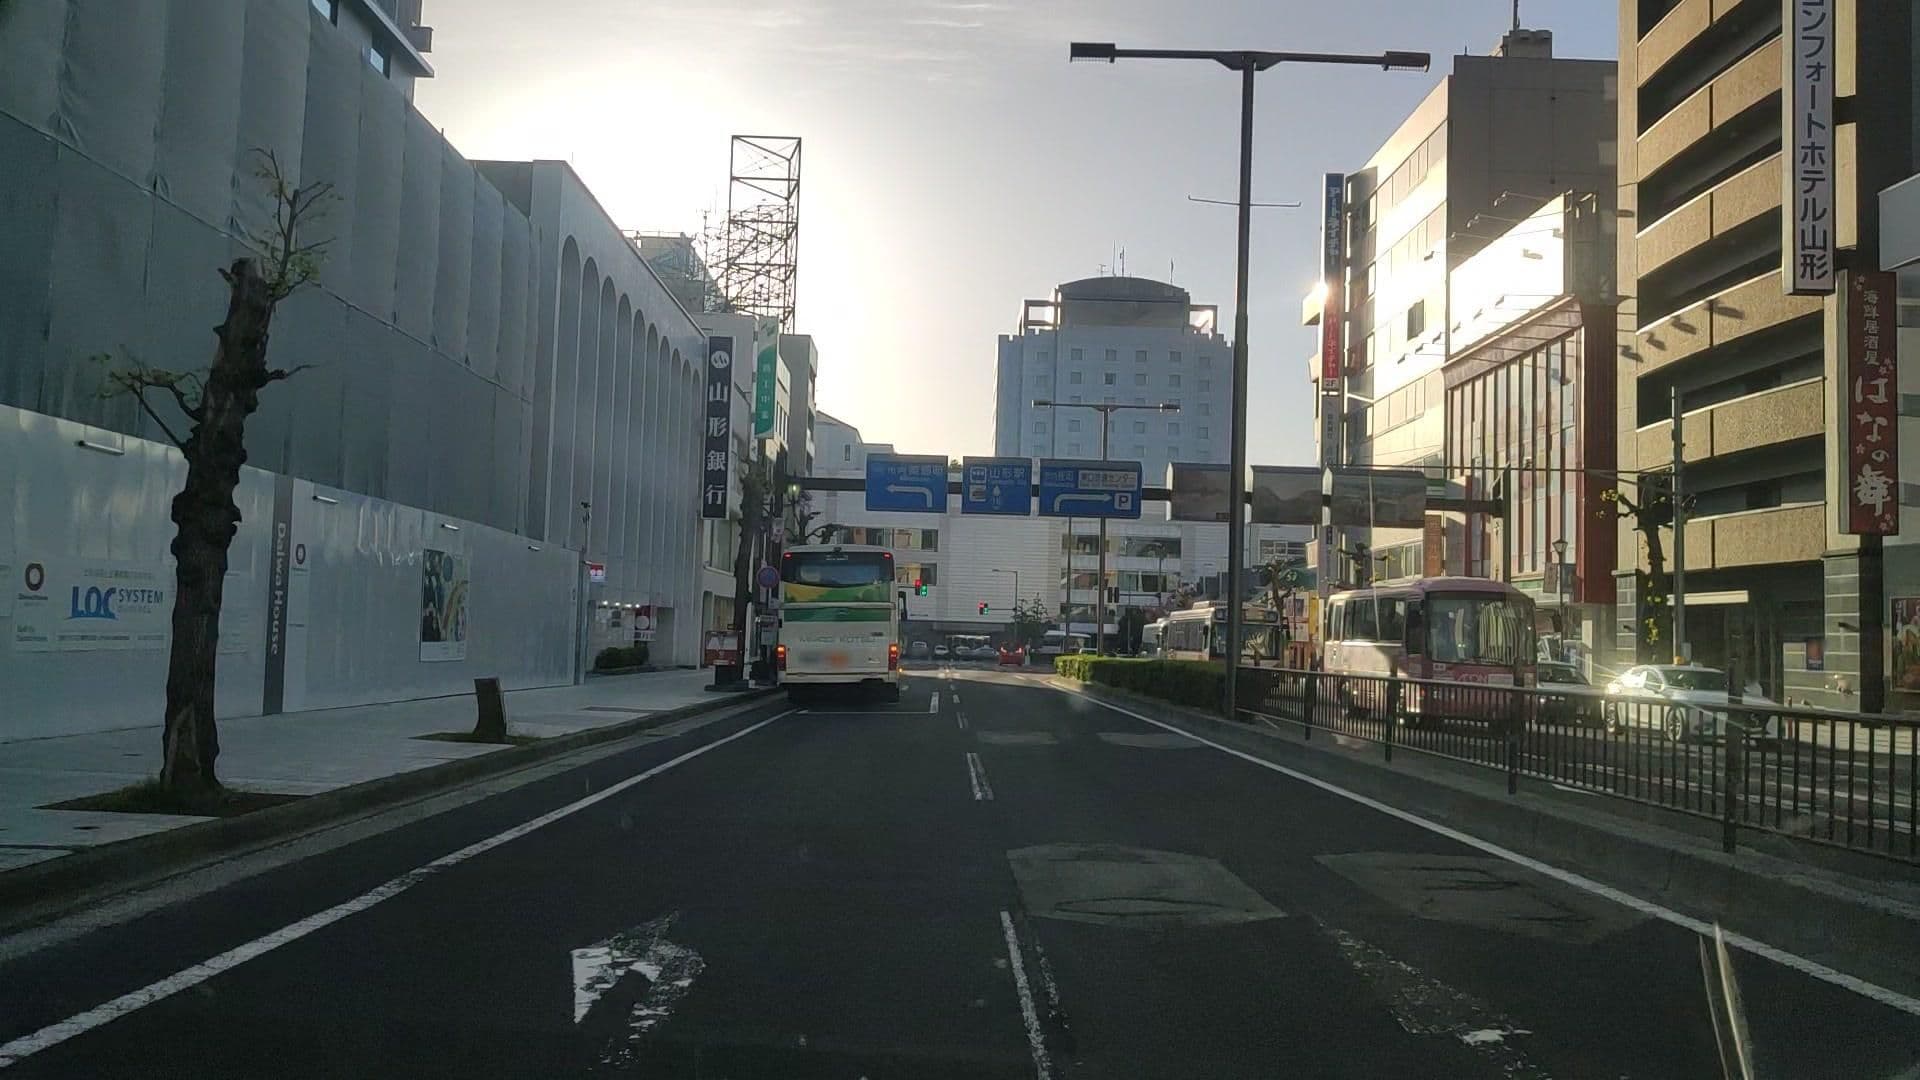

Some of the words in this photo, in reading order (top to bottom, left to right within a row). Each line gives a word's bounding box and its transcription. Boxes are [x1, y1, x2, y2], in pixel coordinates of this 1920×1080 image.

[1863, 290, 1880, 366] 海鮮居酒屋
[705, 384, 729, 505] 山形銀行
[1854, 375, 1894, 517] はなの舞
[1119, 495, 1129, 508] P
[276, 522, 287, 587] Daiwa
[118, 588, 164, 604] SYSTEM
[271, 590, 284, 655] House
